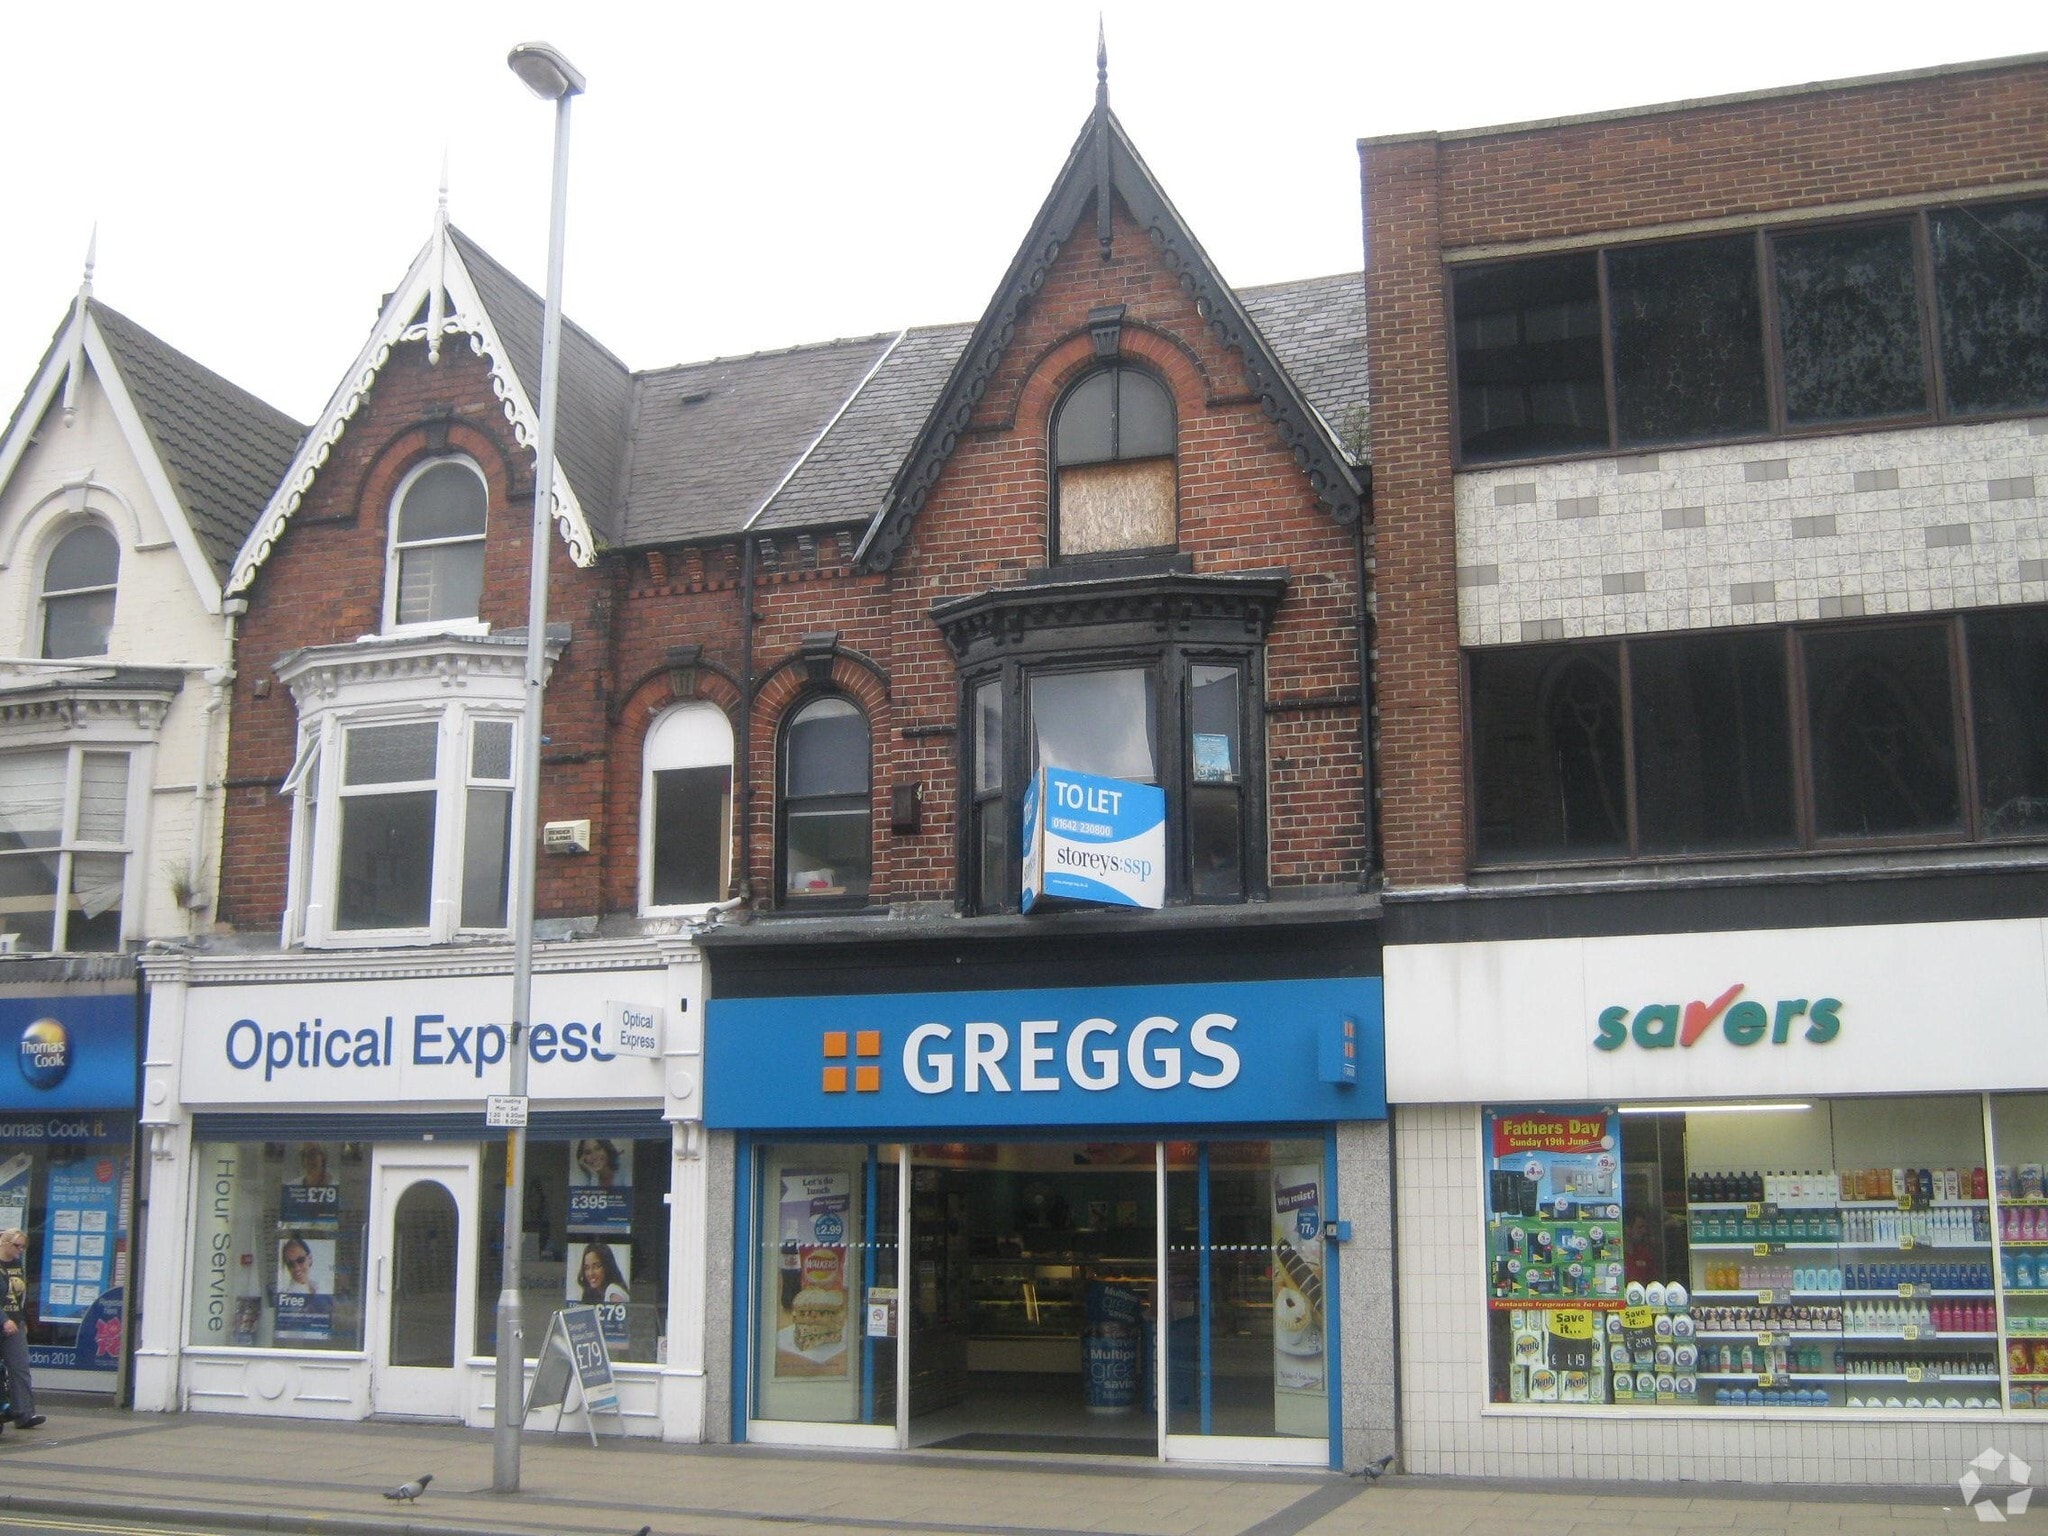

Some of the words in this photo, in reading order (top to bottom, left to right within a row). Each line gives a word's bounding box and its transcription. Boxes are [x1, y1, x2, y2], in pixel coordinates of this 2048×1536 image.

[1054, 781, 1084, 809] TO
[1087, 787, 1122, 815] LET
[1053, 817, 1077, 832] 01642
[1080, 821, 1111, 837] 230800
[622, 1010, 653, 1030] Optical
[1593, 983, 1842, 1051] savers
[21, 1041, 65, 1054] Thomas
[620, 1030, 655, 1050] Express
[226, 1015, 393, 1082] Optical
[902, 1013, 1241, 1096] GREGGS
[35, 1054, 65, 1068] Cook
[48, 1120, 89, 1137] Cook
[1503, 1120, 1564, 1135] Fathers
[1568, 1119, 1600, 1137] Day
[1510, 1137, 1542, 1147] Sunday
[1544, 1137, 1565, 1146] 19th
[1567, 1137, 1590, 1146] June
[803, 1177, 821, 1186] Let's
[214, 1159, 235, 1223] Hour
[307, 1187, 336, 1202] £79
[807, 1187, 831, 1195] lunch
[1291, 1189, 1315, 1203] resist?
[571, 1195, 607, 1209] £395
[816, 1225, 842, 1235] £2.99
[1301, 1223, 1315, 1235] 77p
[208, 1232, 231, 1332] Service
[279, 1294, 305, 1306] Free
[597, 1304, 626, 1321] £79
[1556, 1313, 1585, 1323] Save
[1625, 1309, 1646, 1319] Save
[1560, 1324, 1582, 1334] it...
[1515, 1341, 1540, 1356] Plenty
[1635, 1338, 1652, 1347] 2.99
[51, 1352, 76, 1365] 2012
[576, 1341, 602, 1369] £79
[1531, 1376, 1556, 1391] Plenty
